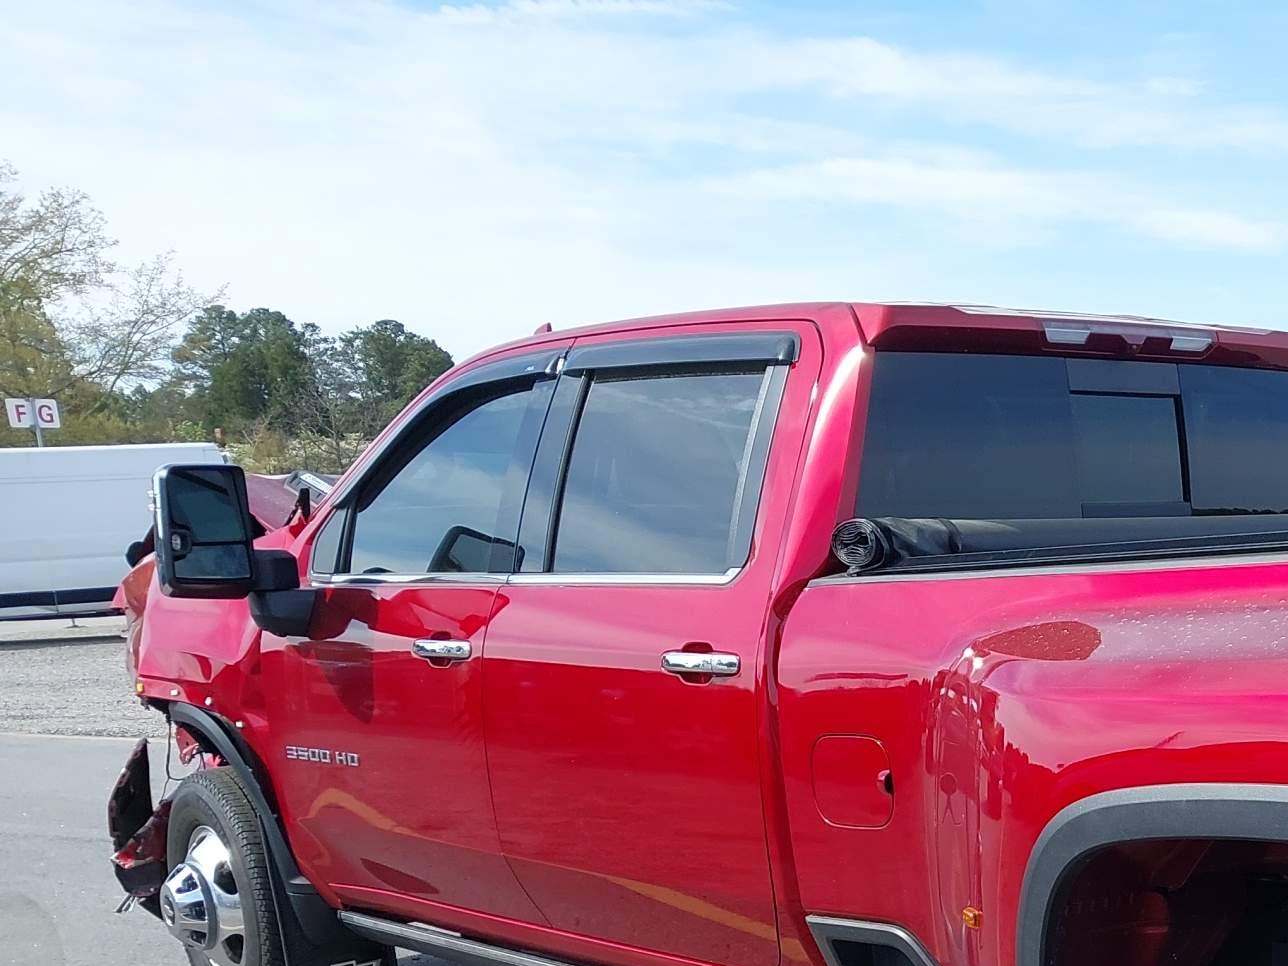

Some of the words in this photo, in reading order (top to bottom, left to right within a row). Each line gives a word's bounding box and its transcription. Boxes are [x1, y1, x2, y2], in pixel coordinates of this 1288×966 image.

[15, 404, 26, 423] F
[38, 404, 54, 423] G
[286, 745, 331, 763] 3500
[335, 751, 359, 767] HD
